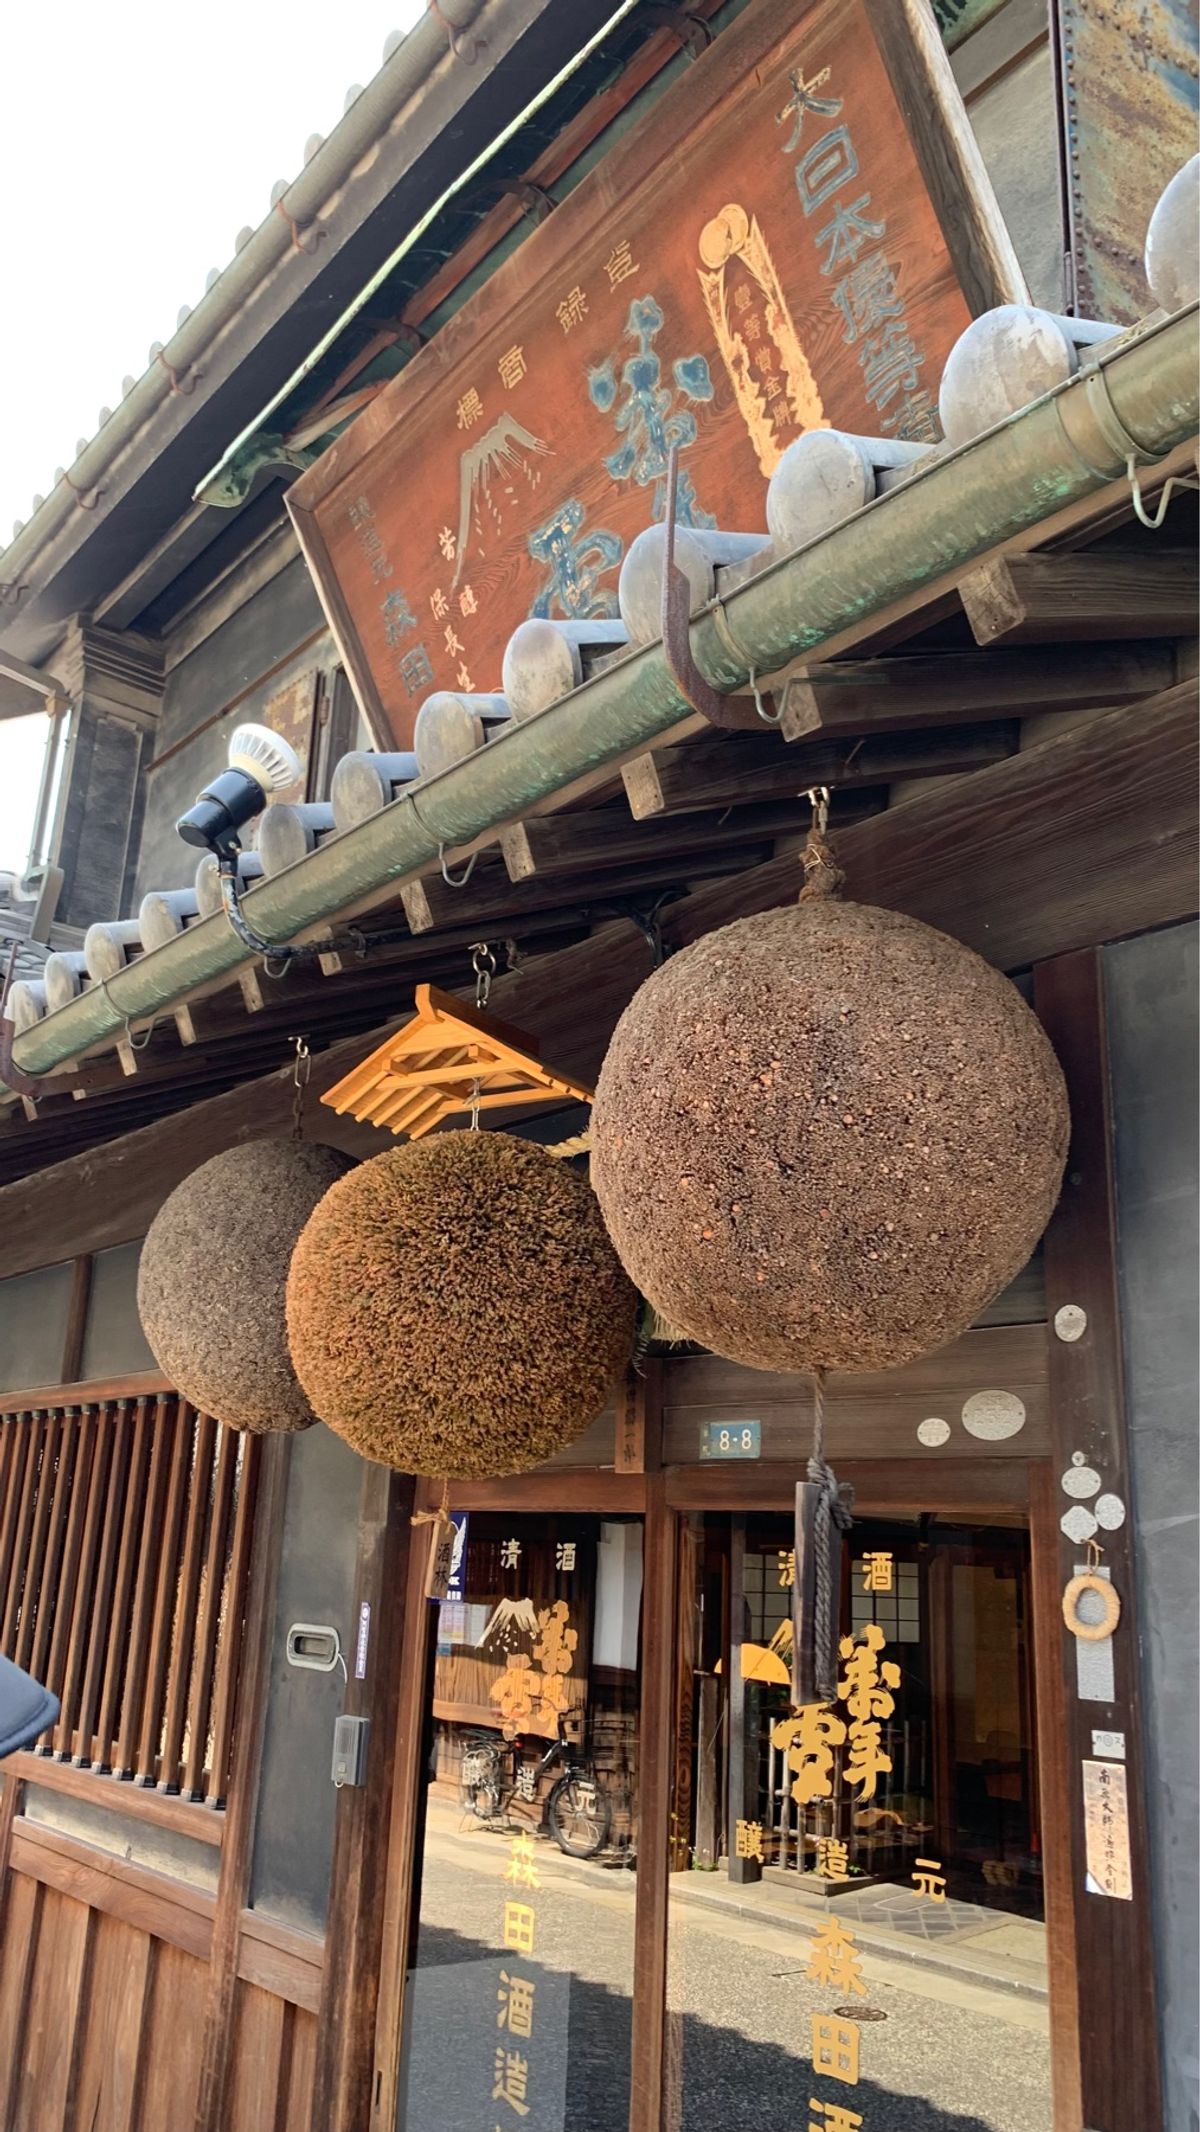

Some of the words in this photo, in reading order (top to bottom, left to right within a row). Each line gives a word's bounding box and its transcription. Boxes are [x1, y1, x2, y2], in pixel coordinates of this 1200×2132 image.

[501, 1538, 577, 1571] 清酒
[491, 1829, 542, 2132] 森田酒造
